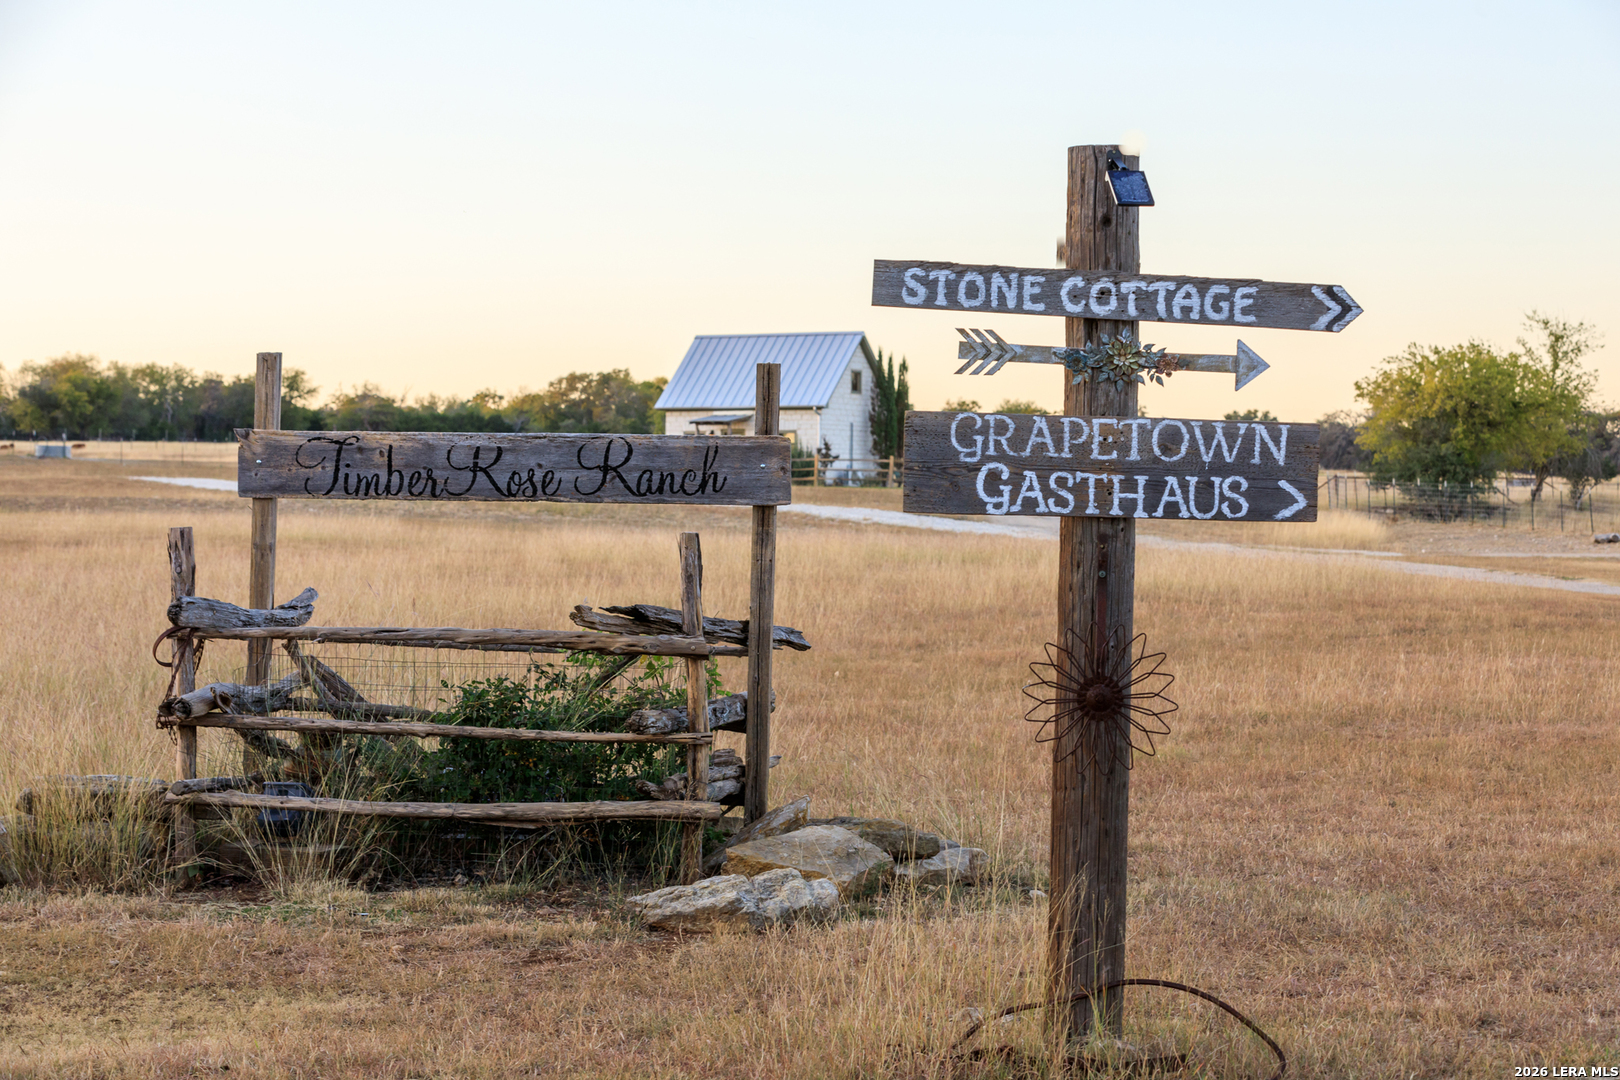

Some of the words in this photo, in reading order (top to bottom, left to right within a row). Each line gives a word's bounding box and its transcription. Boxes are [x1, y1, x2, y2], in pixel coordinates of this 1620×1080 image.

[901, 267, 1046, 312] STONE
[1060, 275, 1259, 323] COTTAGE
[296, 436, 443, 498] Timber
[443, 438, 562, 498] Rose
[574, 436, 728, 498] Ranch
[950, 411, 1290, 469] GRAPETOWN
[976, 461, 1249, 519] GASTHAUS
